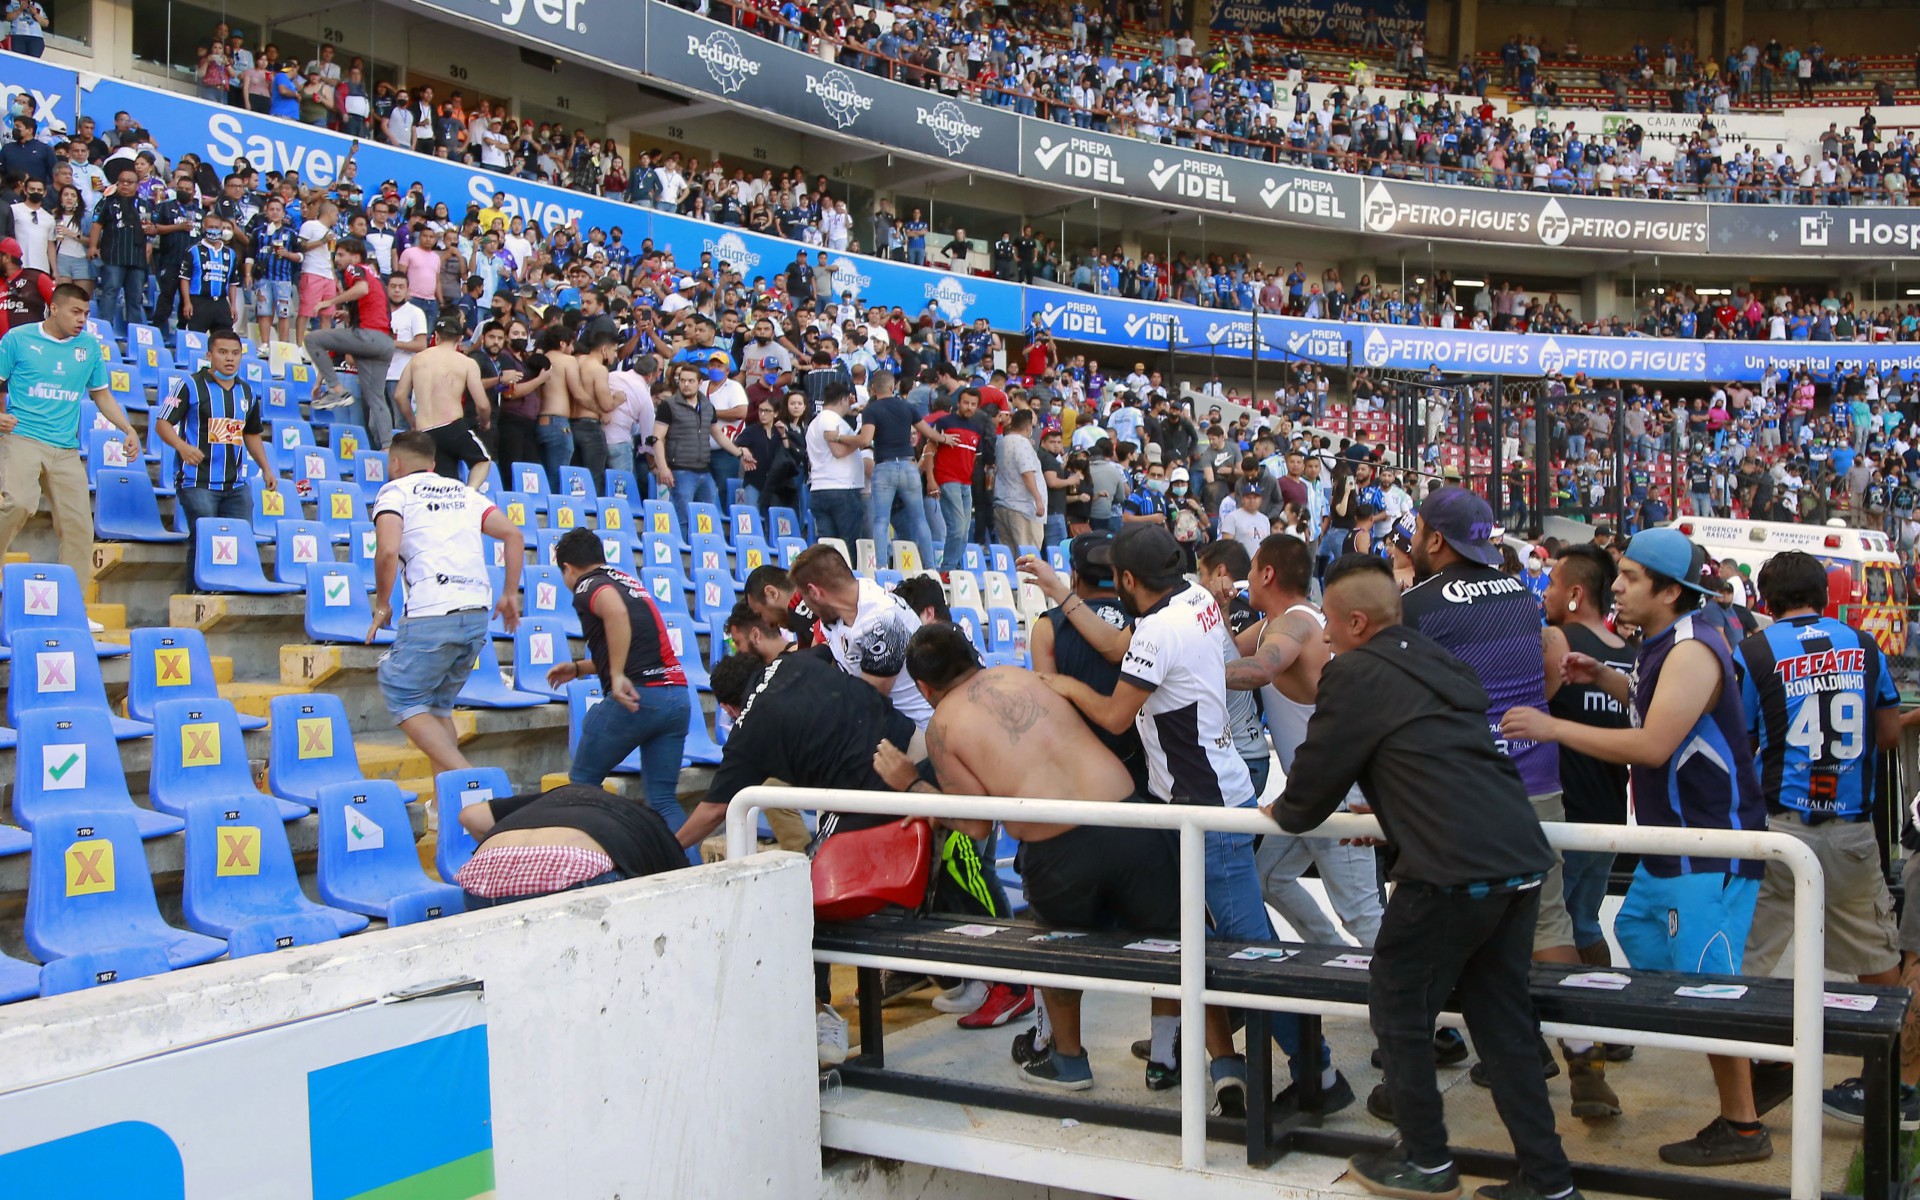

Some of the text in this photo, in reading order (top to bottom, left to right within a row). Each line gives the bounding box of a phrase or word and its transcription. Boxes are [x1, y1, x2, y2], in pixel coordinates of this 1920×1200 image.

[480, 0, 586, 31] yer
[1224, 6, 1277, 23] CRUNCH
[323, 27, 343, 43] 29
[687, 35, 758, 76] Pedigree
[450, 64, 468, 81] 30
[806, 74, 872, 110] Pedigree
[557, 96, 570, 110] 31
[917, 106, 981, 138] Pedigree
[1647, 117, 1677, 127] CAJA
[669, 126, 684, 140] 32
[1070, 138, 1113, 158] PREPA
[1064, 152, 1125, 185] IDEL
[1183, 159, 1225, 178] PREPA
[1177, 172, 1237, 203] IDEL
[1293, 177, 1334, 194] PREPA
[1288, 192, 1346, 219] IDEL
[1396, 203, 1457, 227] PETRO
[1570, 217, 1631, 239] PETRO
[703, 239, 760, 267] Pedigree
[925, 283, 976, 305] Pedigree
[1066, 301, 1098, 316] PREPA
[1149, 312, 1181, 325] PREPA
[1062, 312, 1107, 335] IDEL
[1145, 322, 1189, 344] IDEL
[1231, 321, 1262, 334] PREPA
[1312, 330, 1342, 341] PREPA
[1308, 338, 1349, 358] IDEL
[1389, 338, 1451, 361] PETRO
[1565, 348, 1628, 370] PETRO
[1744, 355, 1765, 369] Un
[1769, 355, 1830, 372] hospital
[28, 382, 79, 402] MULTIVA
[1702, 525, 1743, 534] URGENCIAS
[1772, 531, 1820, 541] PARAMEDICOS
[93, 549, 104, 569] G
[1442, 577, 1523, 604] Corona
[195, 604, 205, 624] F
[302, 655, 313, 679] E
[1134, 656, 1154, 669] ETN
[1774, 648, 1866, 684] TECATE
[1785, 674, 1864, 699] RONALDINHO
[1786, 692, 1864, 760] 49
[1824, 800, 1847, 811] INN
[80, 828, 91, 836] 170
[100, 972, 113, 982] 167
